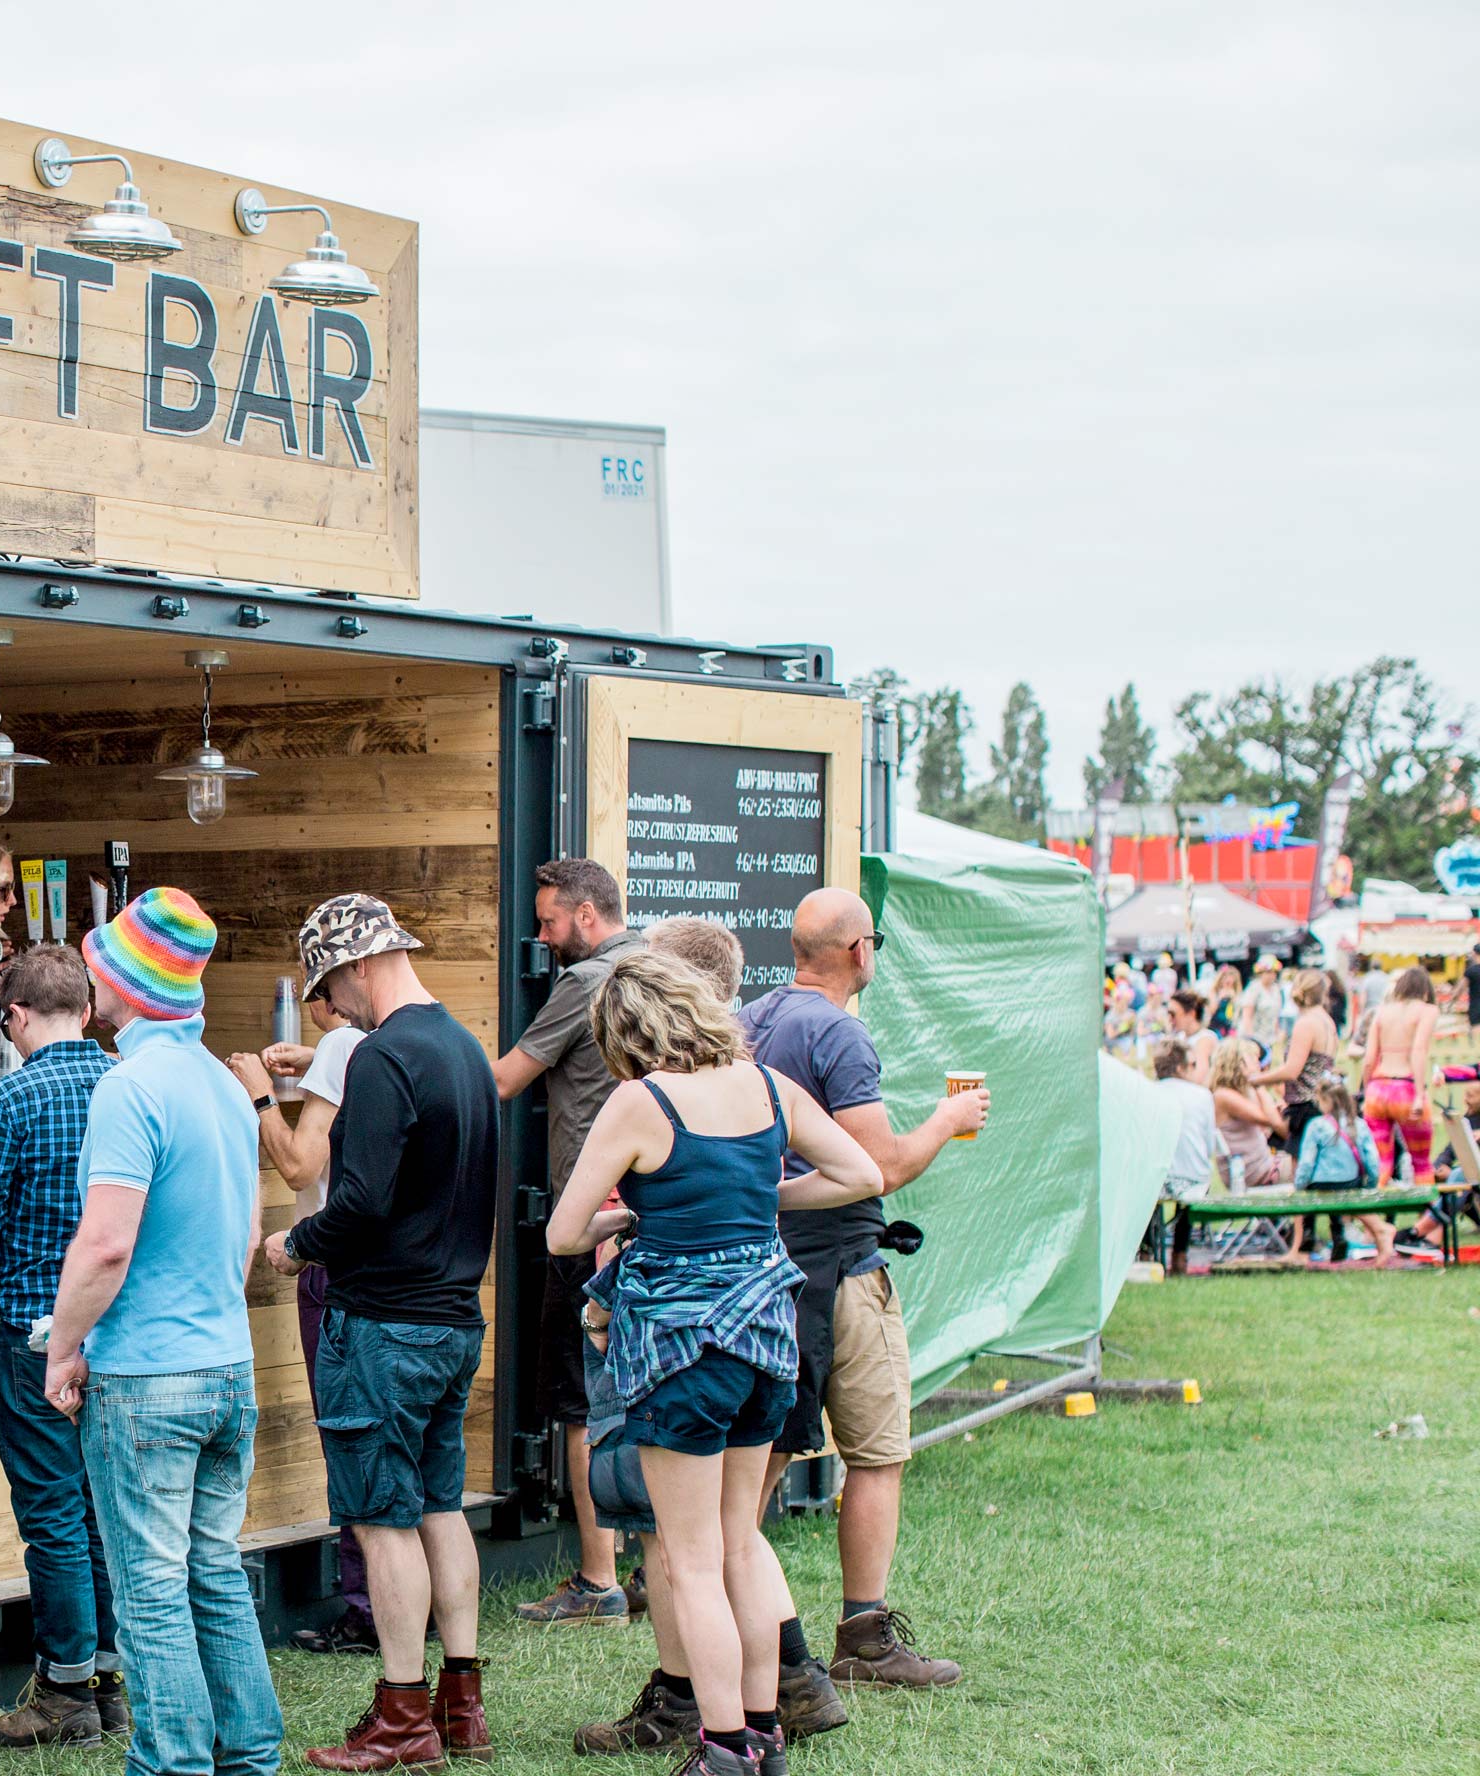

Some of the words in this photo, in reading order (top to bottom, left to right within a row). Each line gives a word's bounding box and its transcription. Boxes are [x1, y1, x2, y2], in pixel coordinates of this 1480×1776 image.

[145, 271, 375, 470] BAR
[602, 457, 644, 482] FRC
[113, 847, 129, 862] IPA
[676, 851, 696, 872] IPA
[23, 867, 42, 876] PILS
[49, 867, 63, 876] IPA
